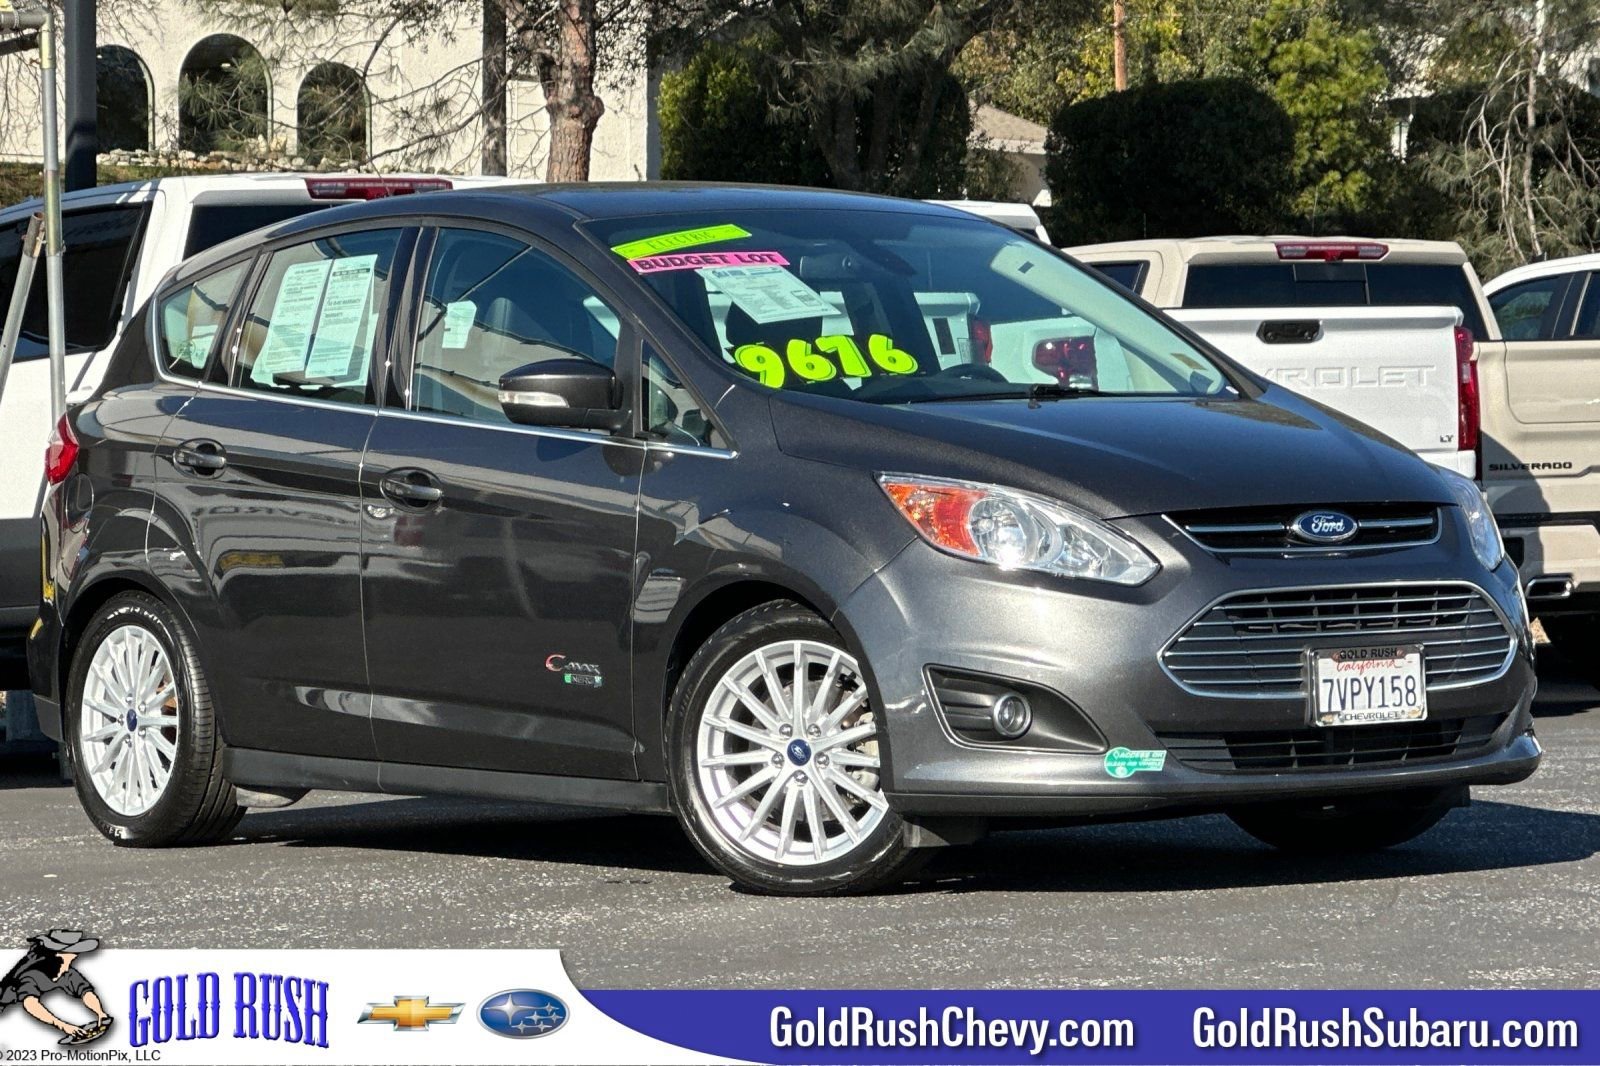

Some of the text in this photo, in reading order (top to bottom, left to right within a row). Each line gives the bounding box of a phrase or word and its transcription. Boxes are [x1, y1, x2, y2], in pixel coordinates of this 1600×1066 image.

[648, 232, 716, 250] ELECTRIC
[634, 253, 779, 270] BUDGET LOT
[734, 333, 919, 389] 9676
[1488, 461, 1573, 472] SILVERADO
[1311, 515, 1346, 534] Ford
[1339, 647, 1398, 660] GOLD RUSH
[1336, 659, 1403, 675] California
[1322, 674, 1417, 713] 7VPY158
[1344, 710, 1402, 721] CHEVROLET
